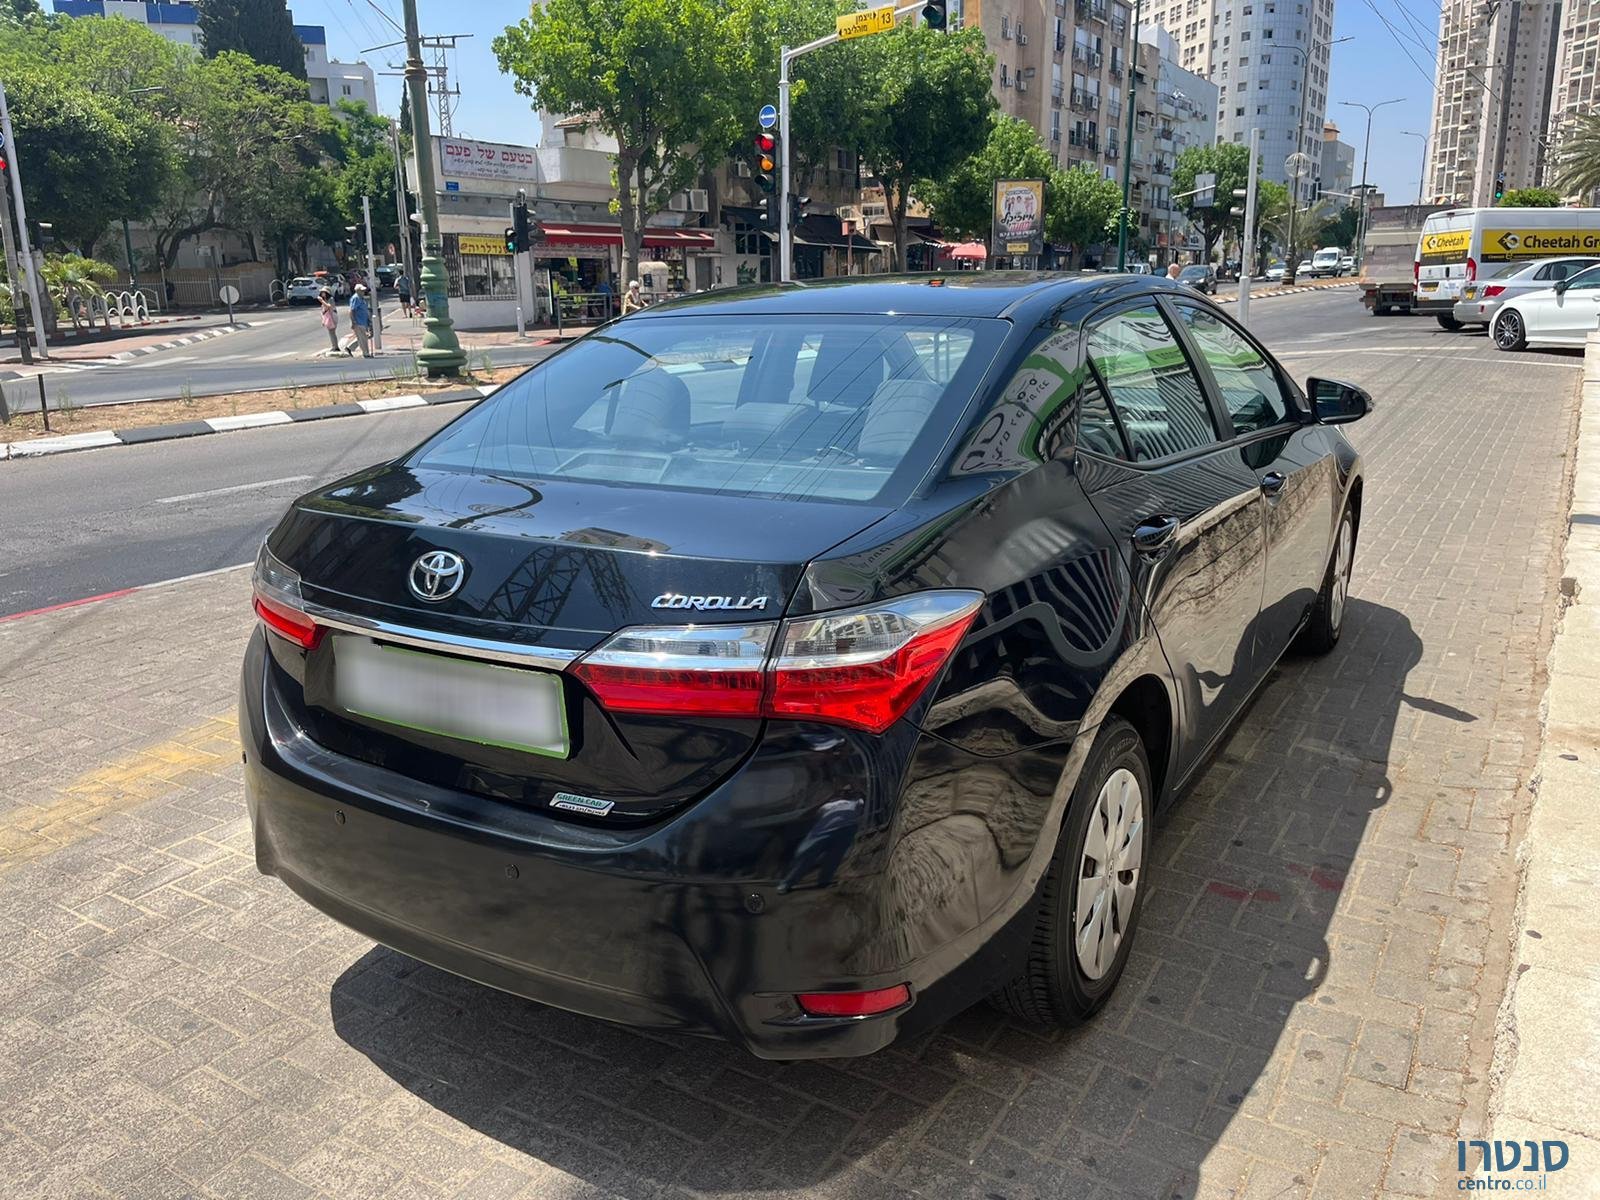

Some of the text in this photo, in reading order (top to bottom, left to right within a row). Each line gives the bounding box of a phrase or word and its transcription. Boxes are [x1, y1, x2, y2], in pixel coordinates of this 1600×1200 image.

[856, 12, 873, 25] ויצמן
[881, 12, 891, 24] 13
[844, 25, 868, 35] מוהליבר
[446, 144, 471, 157] פעם
[476, 145, 496, 160] של
[501, 151, 533, 164] בטעם
[1437, 235, 1464, 248] Cheetah
[1523, 235, 1580, 248] Cheetah
[651, 593, 768, 610] COROLLA
[557, 793, 603, 807] GREEN CAR
